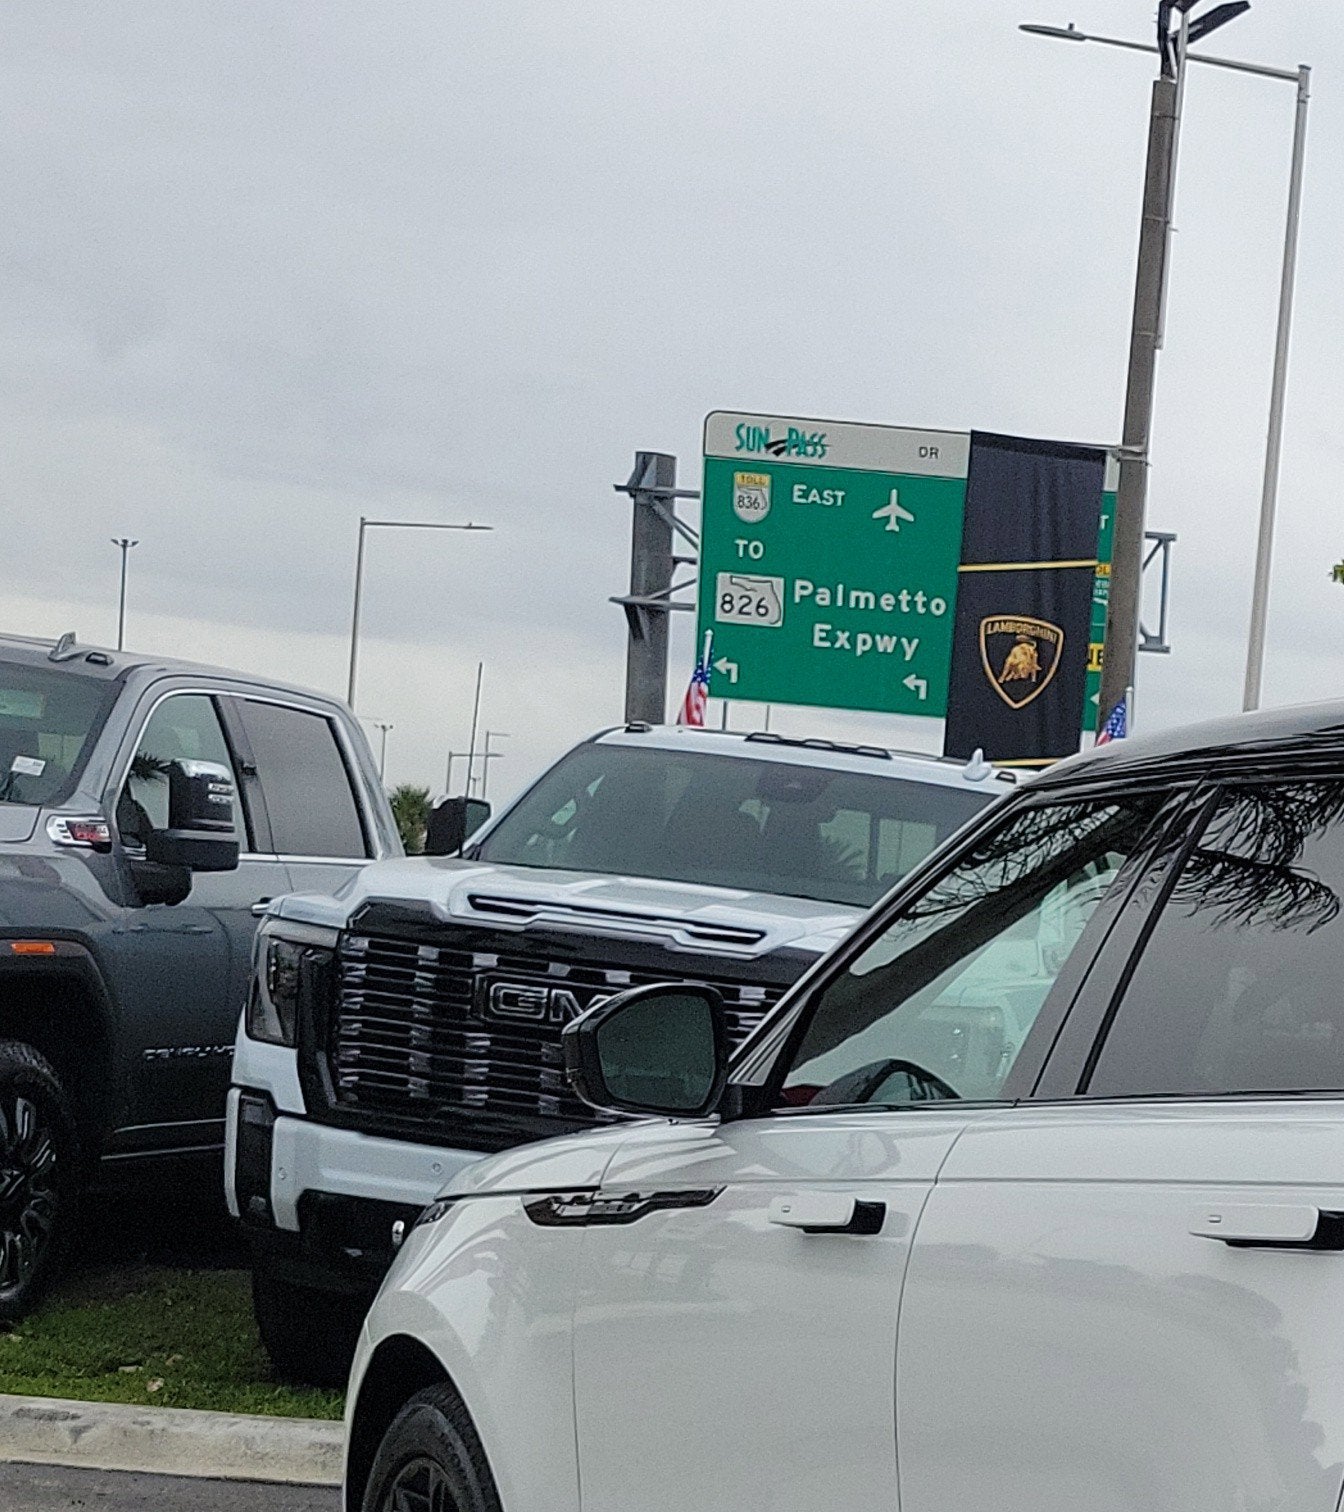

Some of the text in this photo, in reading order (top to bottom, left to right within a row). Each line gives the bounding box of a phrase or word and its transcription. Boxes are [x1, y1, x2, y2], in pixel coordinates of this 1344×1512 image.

[735, 423, 827, 459] SUN PASS
[737, 494, 760, 510] 836
[792, 484, 845, 506] EAST
[734, 539, 764, 559] TO
[720, 592, 770, 617] 826
[793, 578, 947, 616] Palmetto
[812, 623, 919, 661] Expwy
[490, 982, 613, 1022] GM
